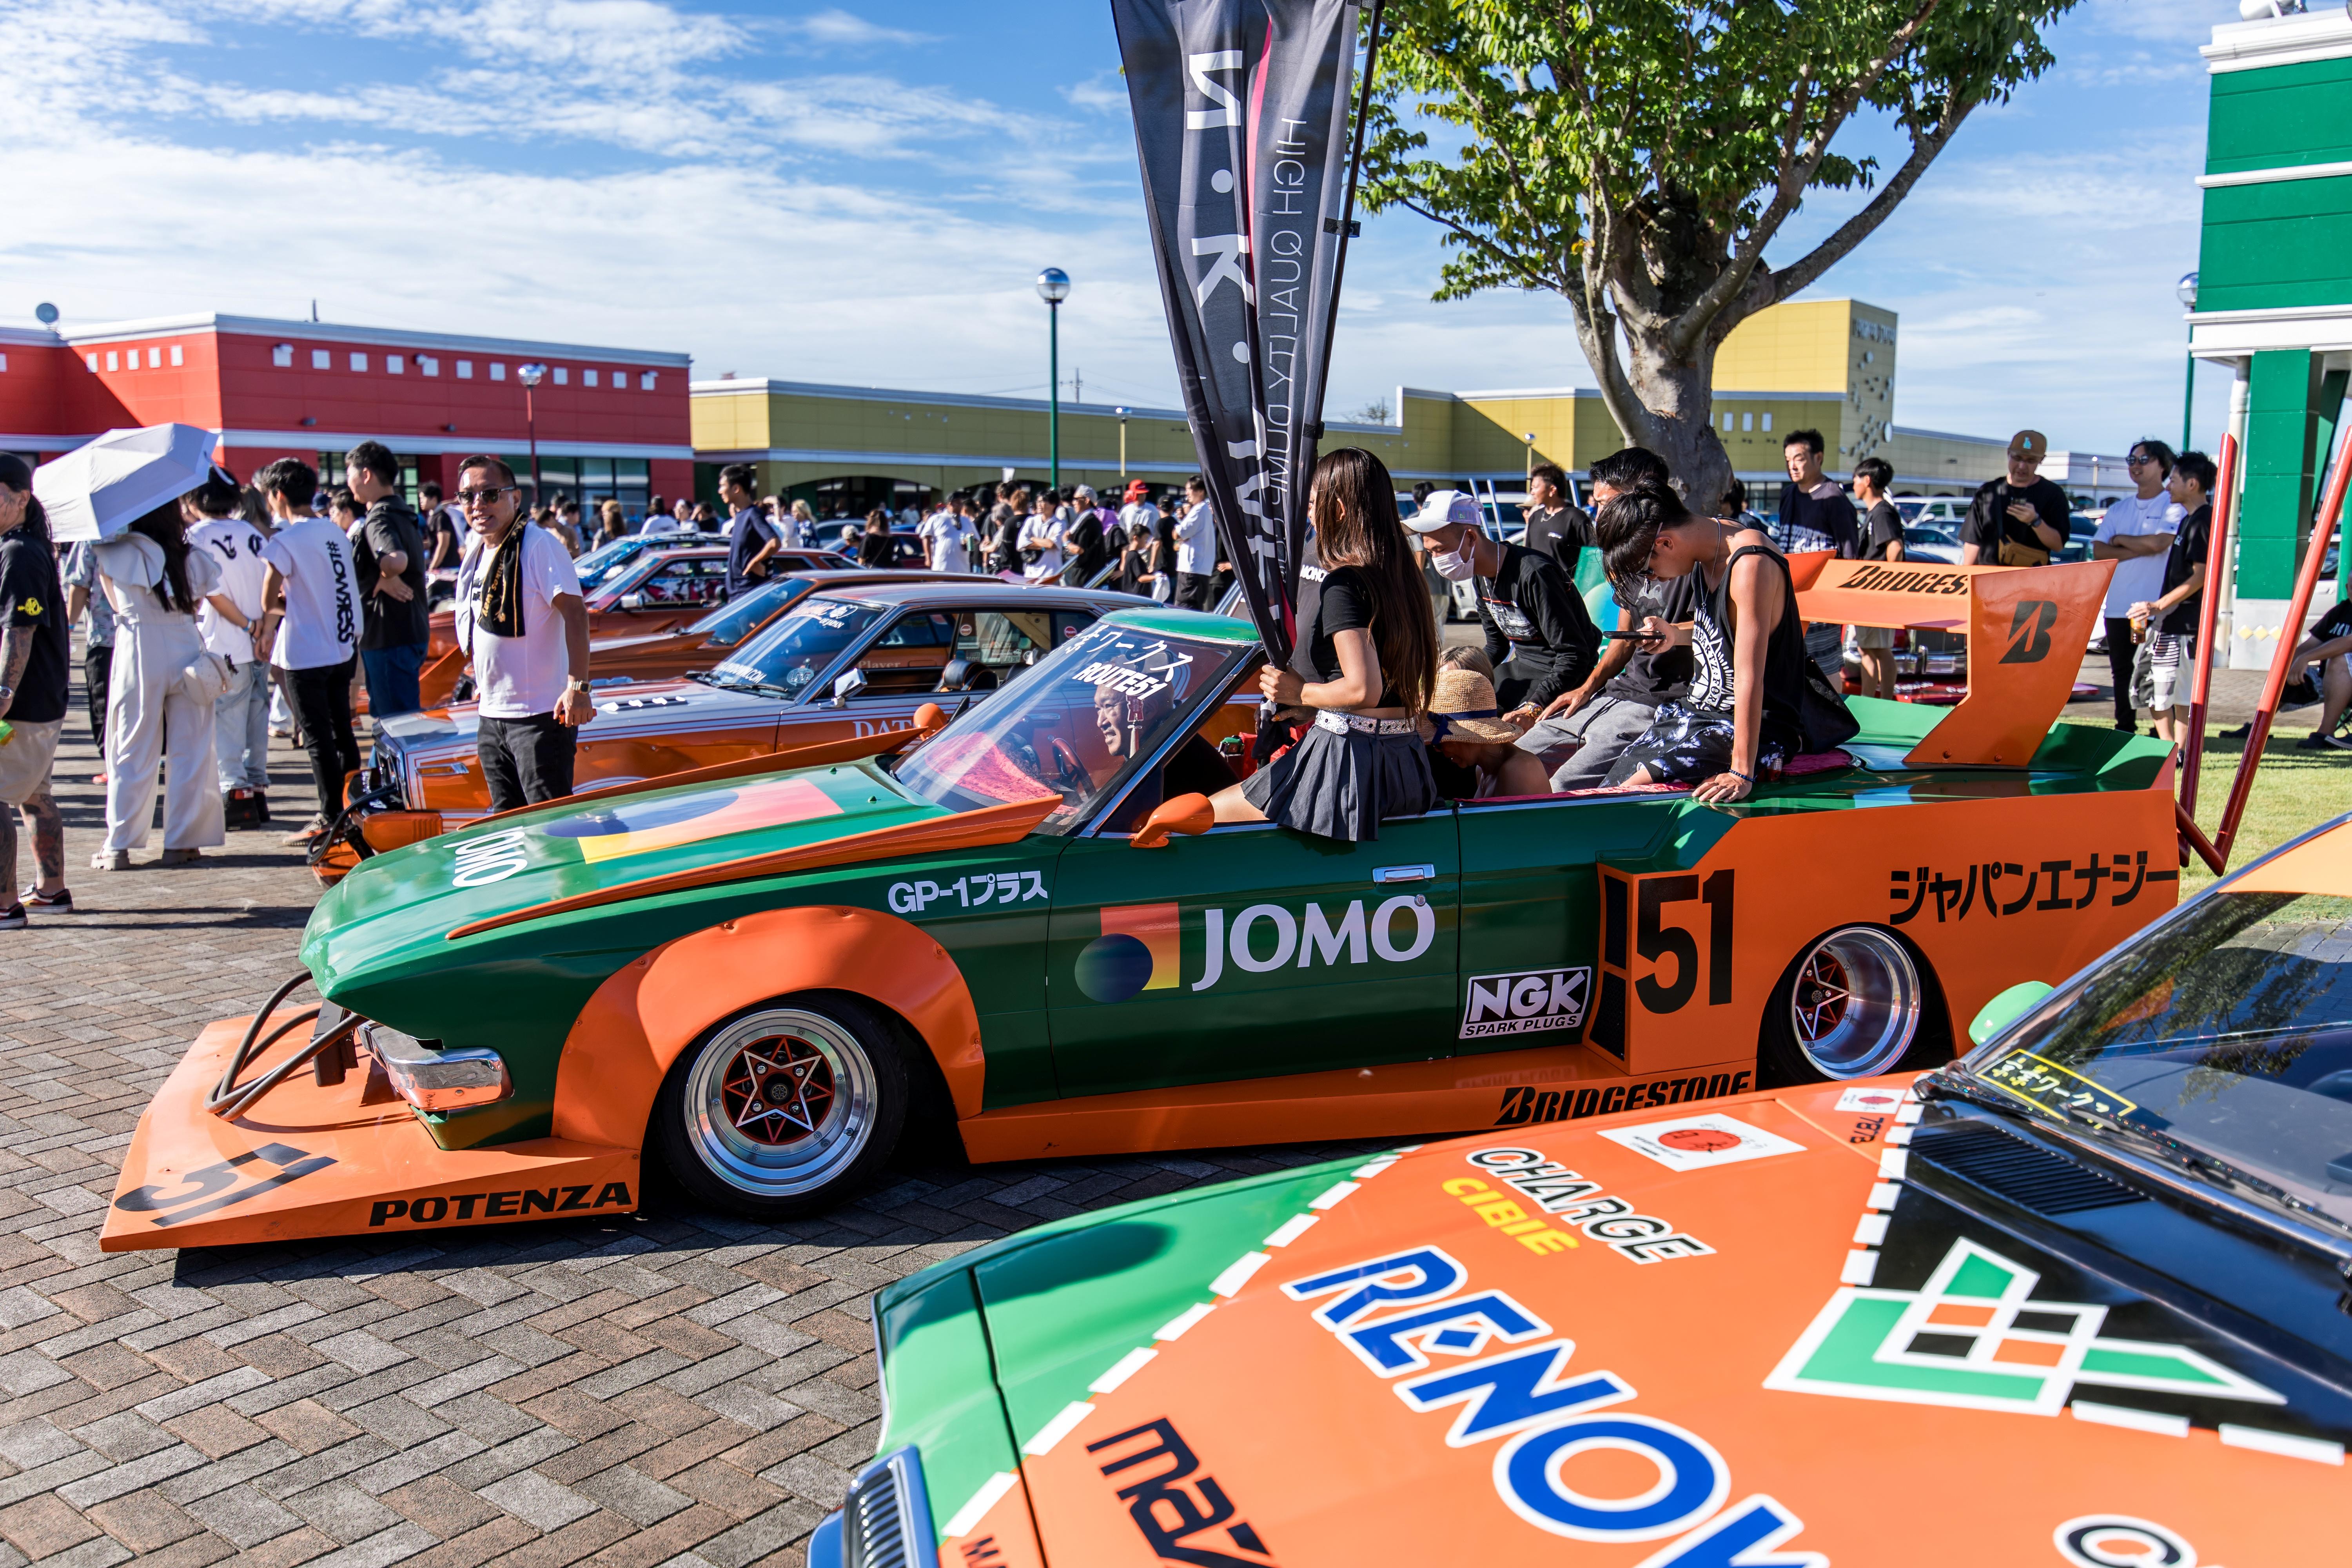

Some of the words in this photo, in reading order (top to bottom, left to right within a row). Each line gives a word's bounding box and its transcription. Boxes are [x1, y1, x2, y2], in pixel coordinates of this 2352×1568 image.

[1837, 565, 1968, 595] BRIDGES
[1072, 662, 1168, 701] ROUTE51
[1708, 678, 1721, 703] FOR
[443, 826, 528, 887] JOMO
[888, 870, 1048, 913] GP-1プラス
[1889, 851, 2178, 926] ジャパンエナジー
[1191, 895, 1436, 991] JOMO
[1634, 868, 1735, 1014] 51
[1466, 970, 1586, 1022] NGK
[1465, 1020, 1518, 1036] SPARK
[1523, 1015, 1577, 1030] PLUGS
[114, 1142, 339, 1228] 51
[368, 1181, 633, 1227] POTENZA
[1465, 1146, 1717, 1265] CHARGE
[1441, 1177, 1580, 1256] CIBIE
